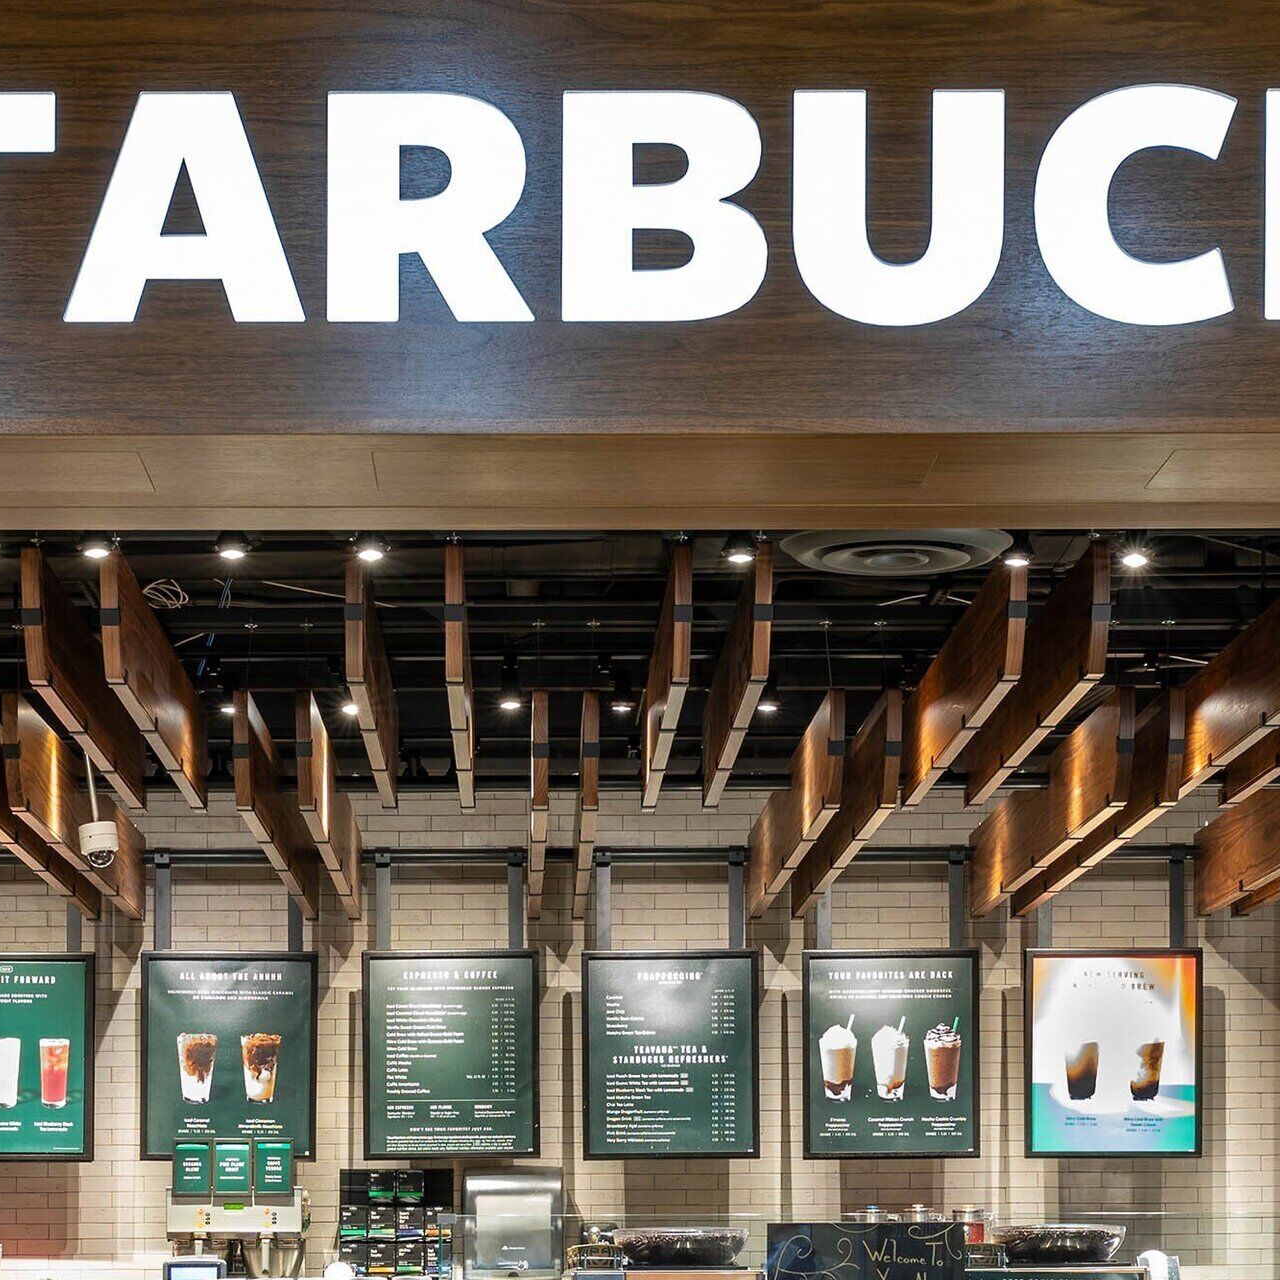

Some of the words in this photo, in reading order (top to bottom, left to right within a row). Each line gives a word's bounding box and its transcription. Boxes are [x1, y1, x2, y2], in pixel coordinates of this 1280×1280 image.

[180, 972, 195, 980] ALL
[200, 972, 228, 980] ABOUT
[233, 972, 249, 980] THE
[403, 971, 449, 979] ESPRESSO
[464, 971, 498, 979] COFFEE
[828, 971, 851, 979] YOUR
[856, 971, 904, 979] FAVORITES
[909, 971, 925, 979] ARE
[930, 971, 953, 979] BACK
[14, 975, 56, 984] FORWARD
[613, 1056, 664, 1064] STARBUCKS
[862, 1238, 927, 1264] Welcome
[925, 1241, 944, 1267] To
